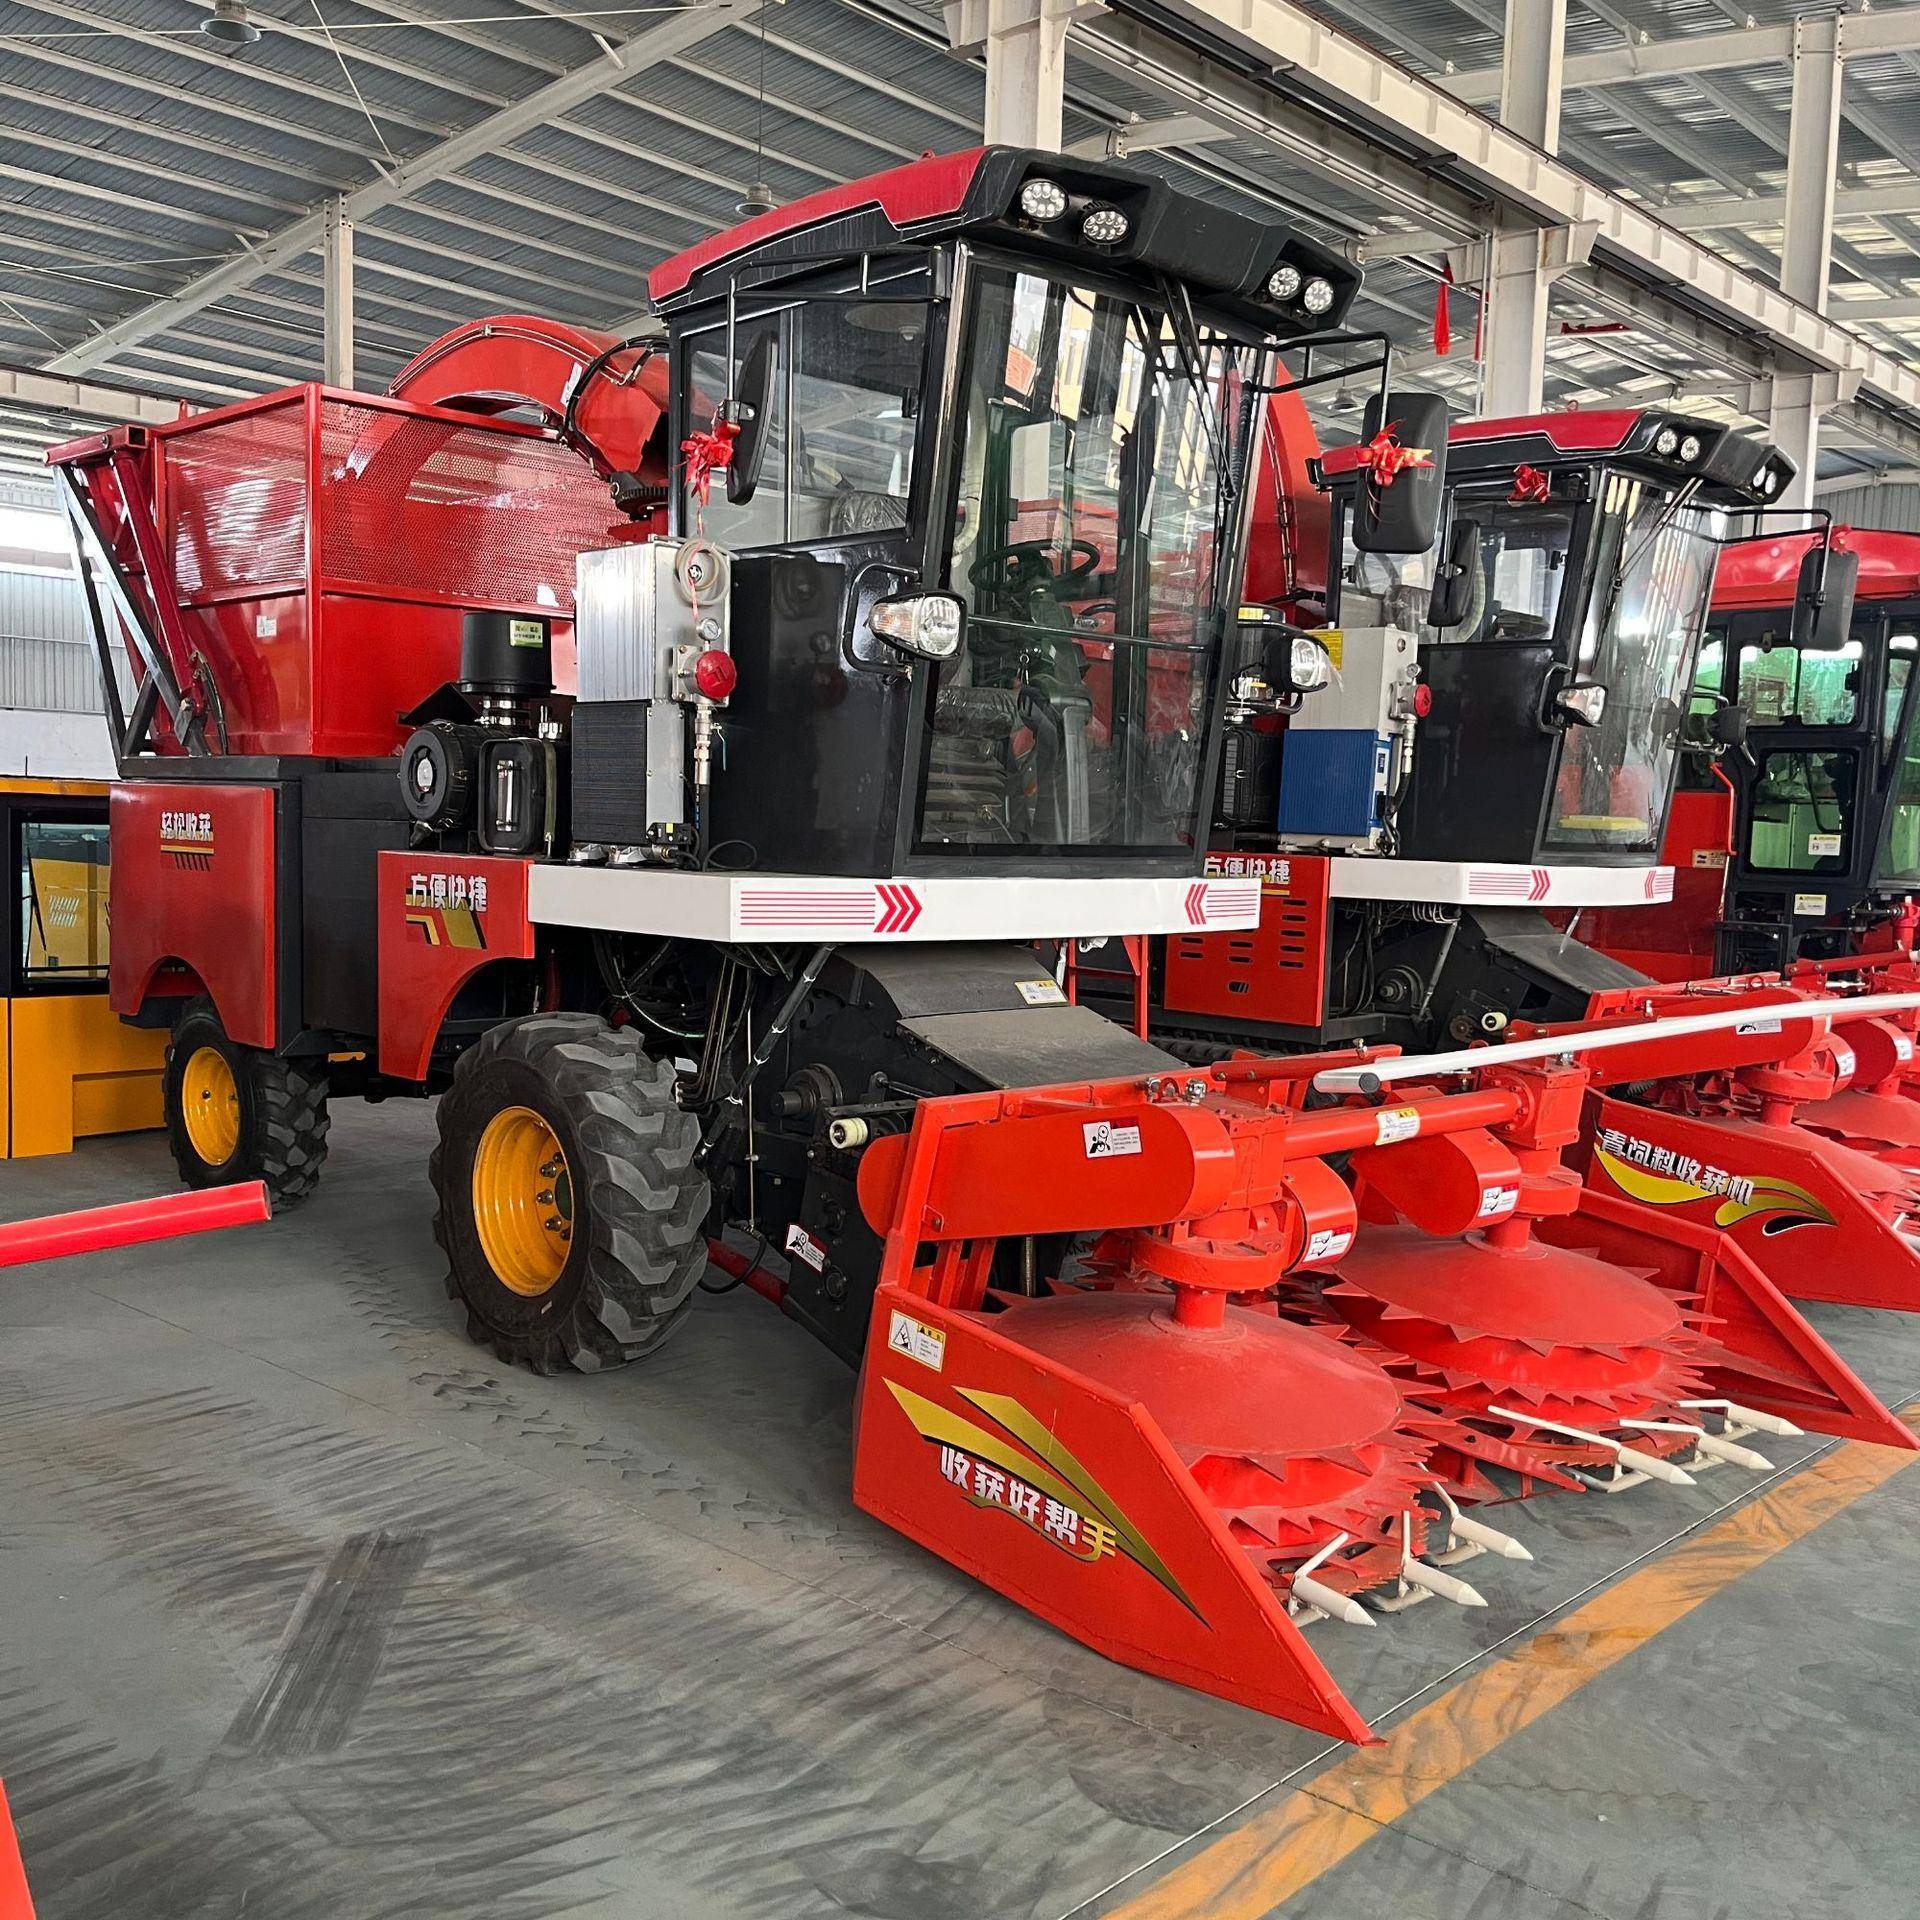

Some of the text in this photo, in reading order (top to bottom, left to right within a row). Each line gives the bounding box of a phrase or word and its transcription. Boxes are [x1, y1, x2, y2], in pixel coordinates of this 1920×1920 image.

[161, 811, 211, 841] 轻松收获
[1203, 856, 1290, 884] 方便快捷
[411, 873, 487, 912] 方便快捷
[1601, 1128, 1755, 1206] 青饲料收获机
[940, 1445, 1117, 1562] 收获好帮手
